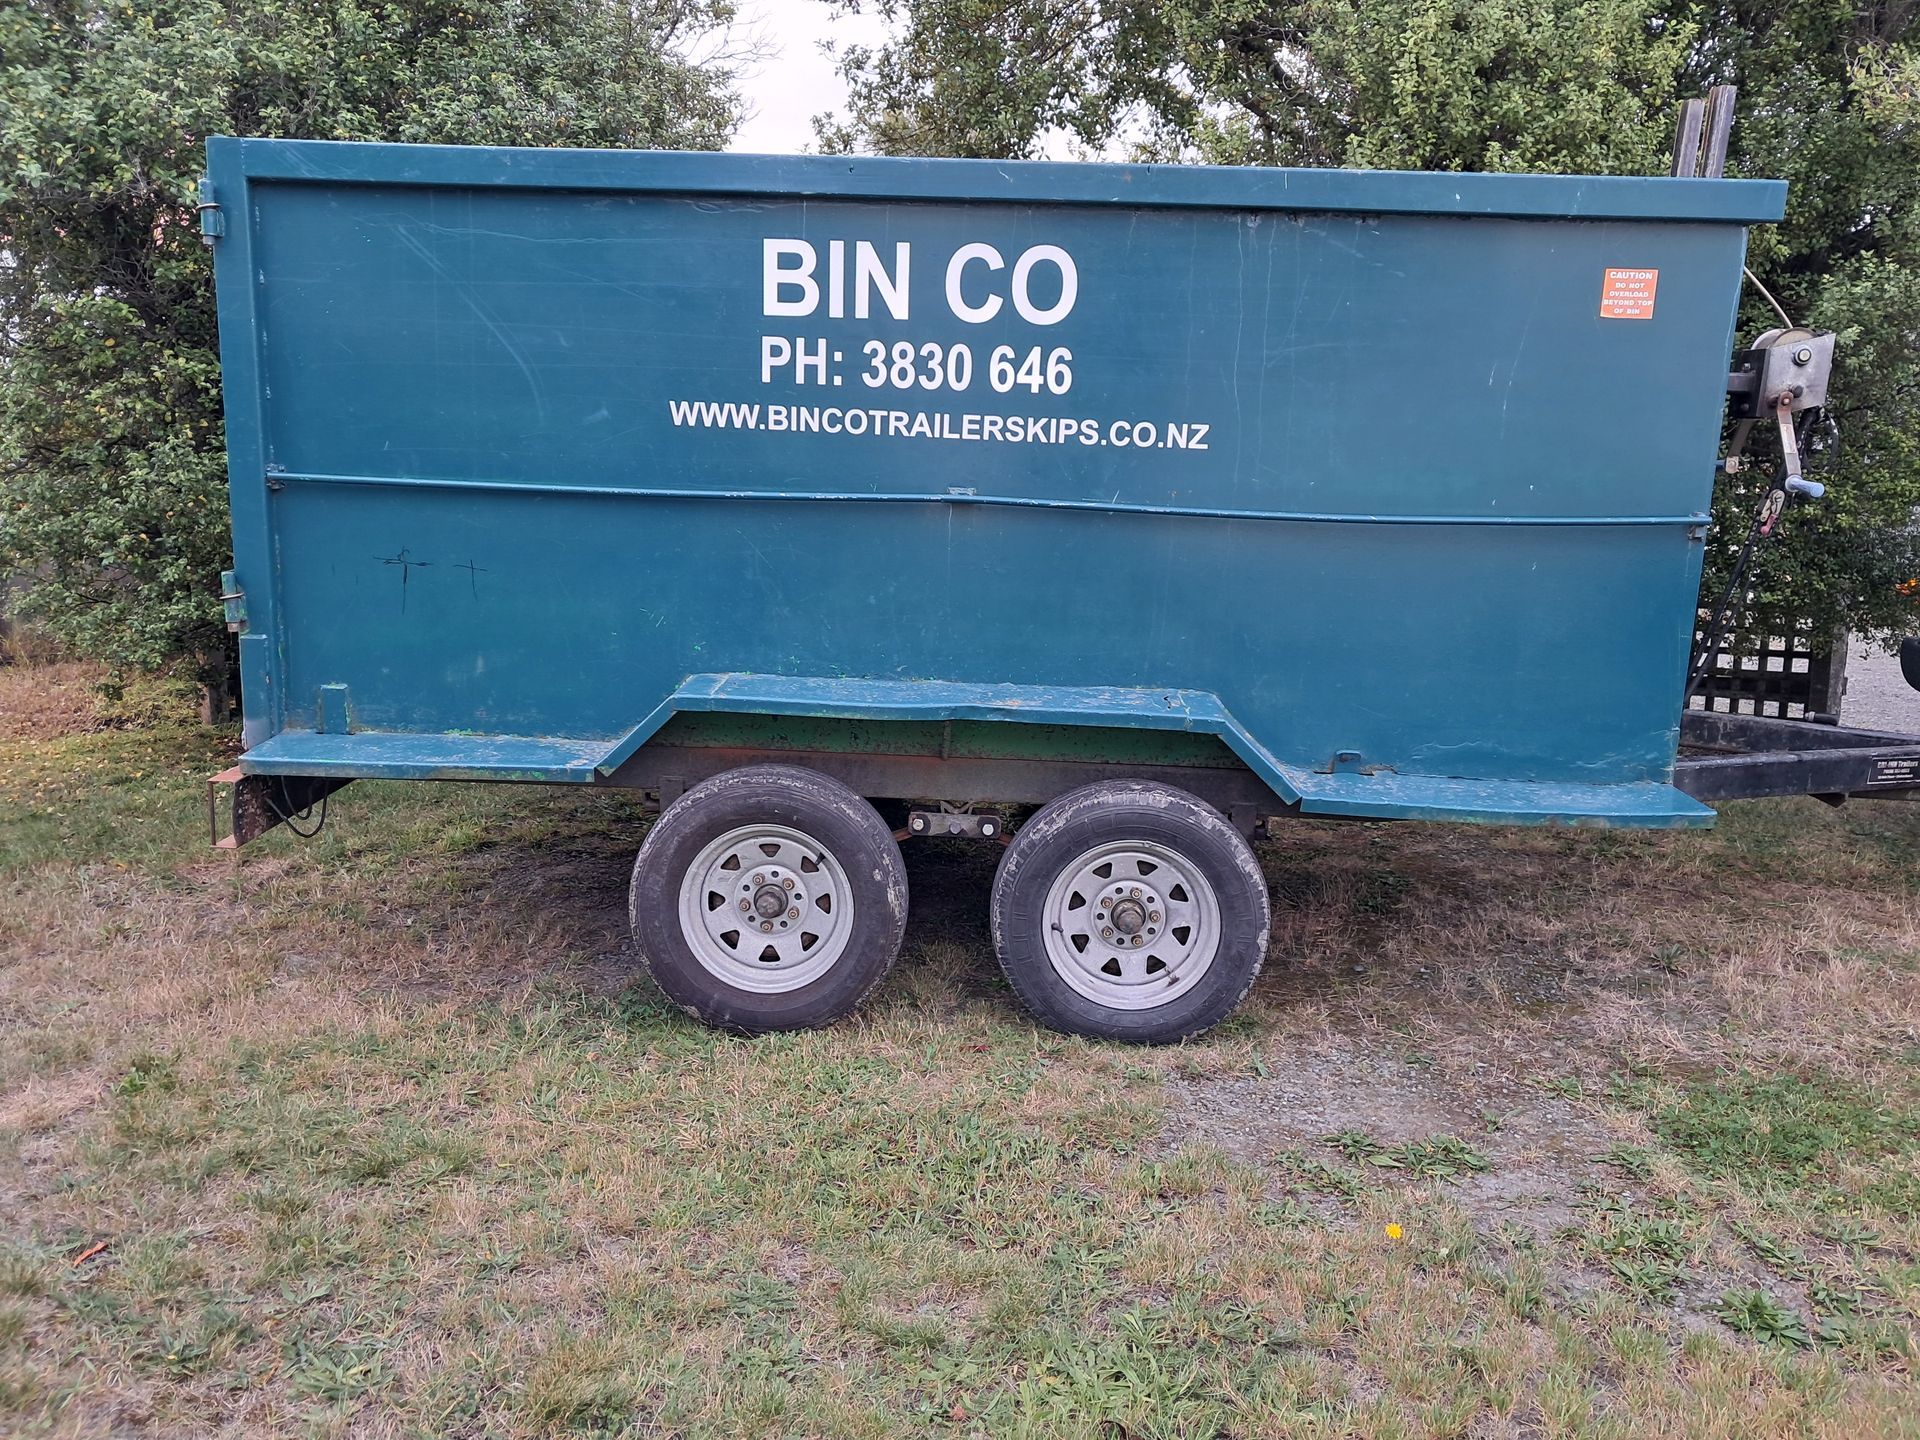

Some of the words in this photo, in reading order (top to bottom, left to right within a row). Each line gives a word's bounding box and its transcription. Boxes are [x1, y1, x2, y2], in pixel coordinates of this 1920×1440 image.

[762, 238, 911, 321] BIN
[945, 242, 1079, 326] CO
[1609, 290, 1649, 298] OVERLOAD
[1610, 271, 1653, 279] CAUTION
[760, 335, 843, 386] PH:
[861, 339, 973, 392] 3830
[988, 345, 1073, 396] 646
[669, 399, 1211, 451] WWW.BINCOTRAILERSKIPS.CO.NZ
